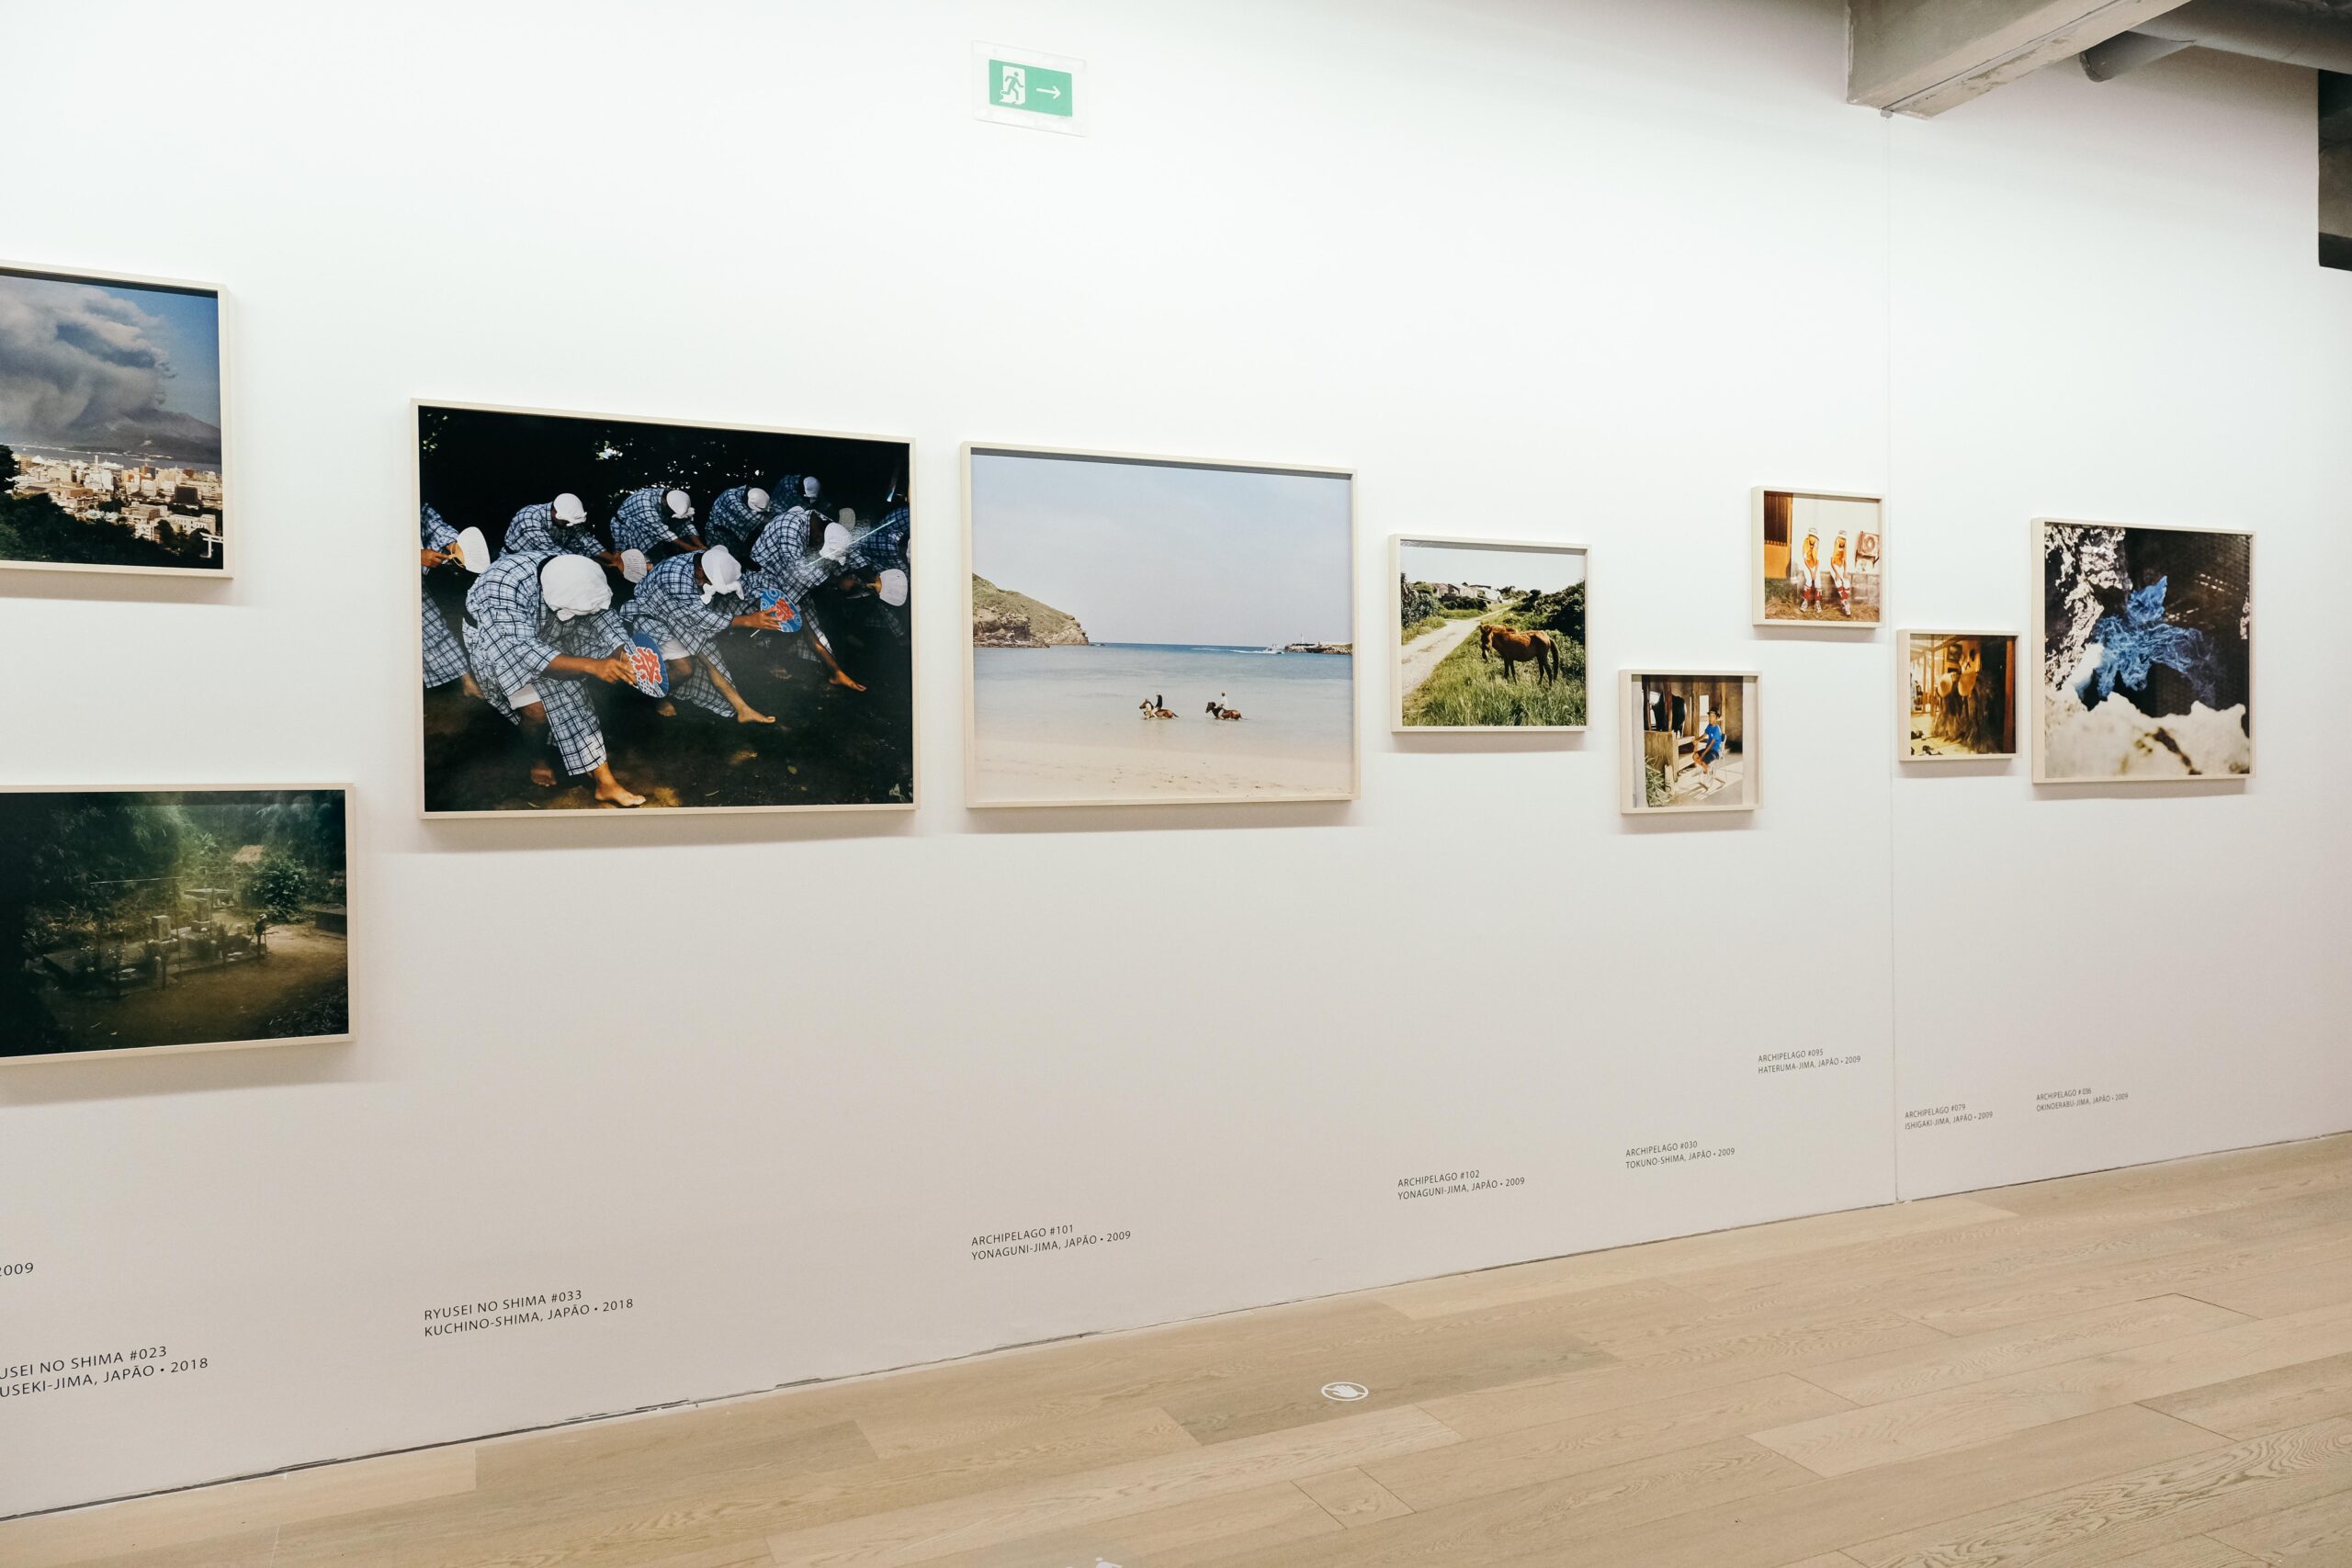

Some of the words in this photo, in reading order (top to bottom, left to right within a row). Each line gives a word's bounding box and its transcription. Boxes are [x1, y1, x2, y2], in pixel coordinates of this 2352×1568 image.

[1758, 1050, 1806, 1063] ARCHIPELAGO
[1807, 1048, 1824, 1057] #095
[1817, 1057, 1838, 1068] JAPÃO
[1845, 1055, 1861, 1065] 2009
[2036, 1089, 2077, 1101] ARCHIPELAGO
[1905, 1106, 1950, 1119] ARCHIPELAGO
[1977, 1111, 1994, 1120] 2009
[1625, 1142, 1679, 1157] ARCHIPELAGO
[1679, 1140, 1698, 1150] #030
[1689, 1149, 1712, 1161] JAPÃO
[1717, 1147, 1736, 1157] 2009
[1397, 1171, 1458, 1188] ARCHIPELAGO
[1460, 1169, 1480, 1180] #102
[1397, 1183, 1469, 1201] YONAGUNI-JIMA,
[1471, 1179, 1498, 1191] JAPÃO
[1505, 1177, 1525, 1188] 2009
[971, 1227, 1046, 1247] ARCHIPELAGO
[1049, 1224, 1074, 1236] #101
[971, 1240, 1061, 1261] YONAGUNI-JIMA,
[1063, 1234, 1098, 1249] JAPÃO
[1106, 1230, 1132, 1243] 2009
[0, 1262, 34, 1277] 009
[424, 1303, 472, 1321] RYUSEI
[477, 1301, 499, 1314] NO
[503, 1294, 547, 1310] SHIMA
[551, 1289, 582, 1303] #033
[424, 1311, 544, 1337] KUCHINO-SHIMA,
[548, 1303, 590, 1321] JAPÃO
[603, 1298, 634, 1313] 2018
[40, 1359, 65, 1374] NO
[71, 1351, 124, 1370] SHIMA
[130, 1346, 167, 1361] #023
[103, 1364, 154, 1383] JAPÃO
[170, 1358, 209, 1374] 2018
